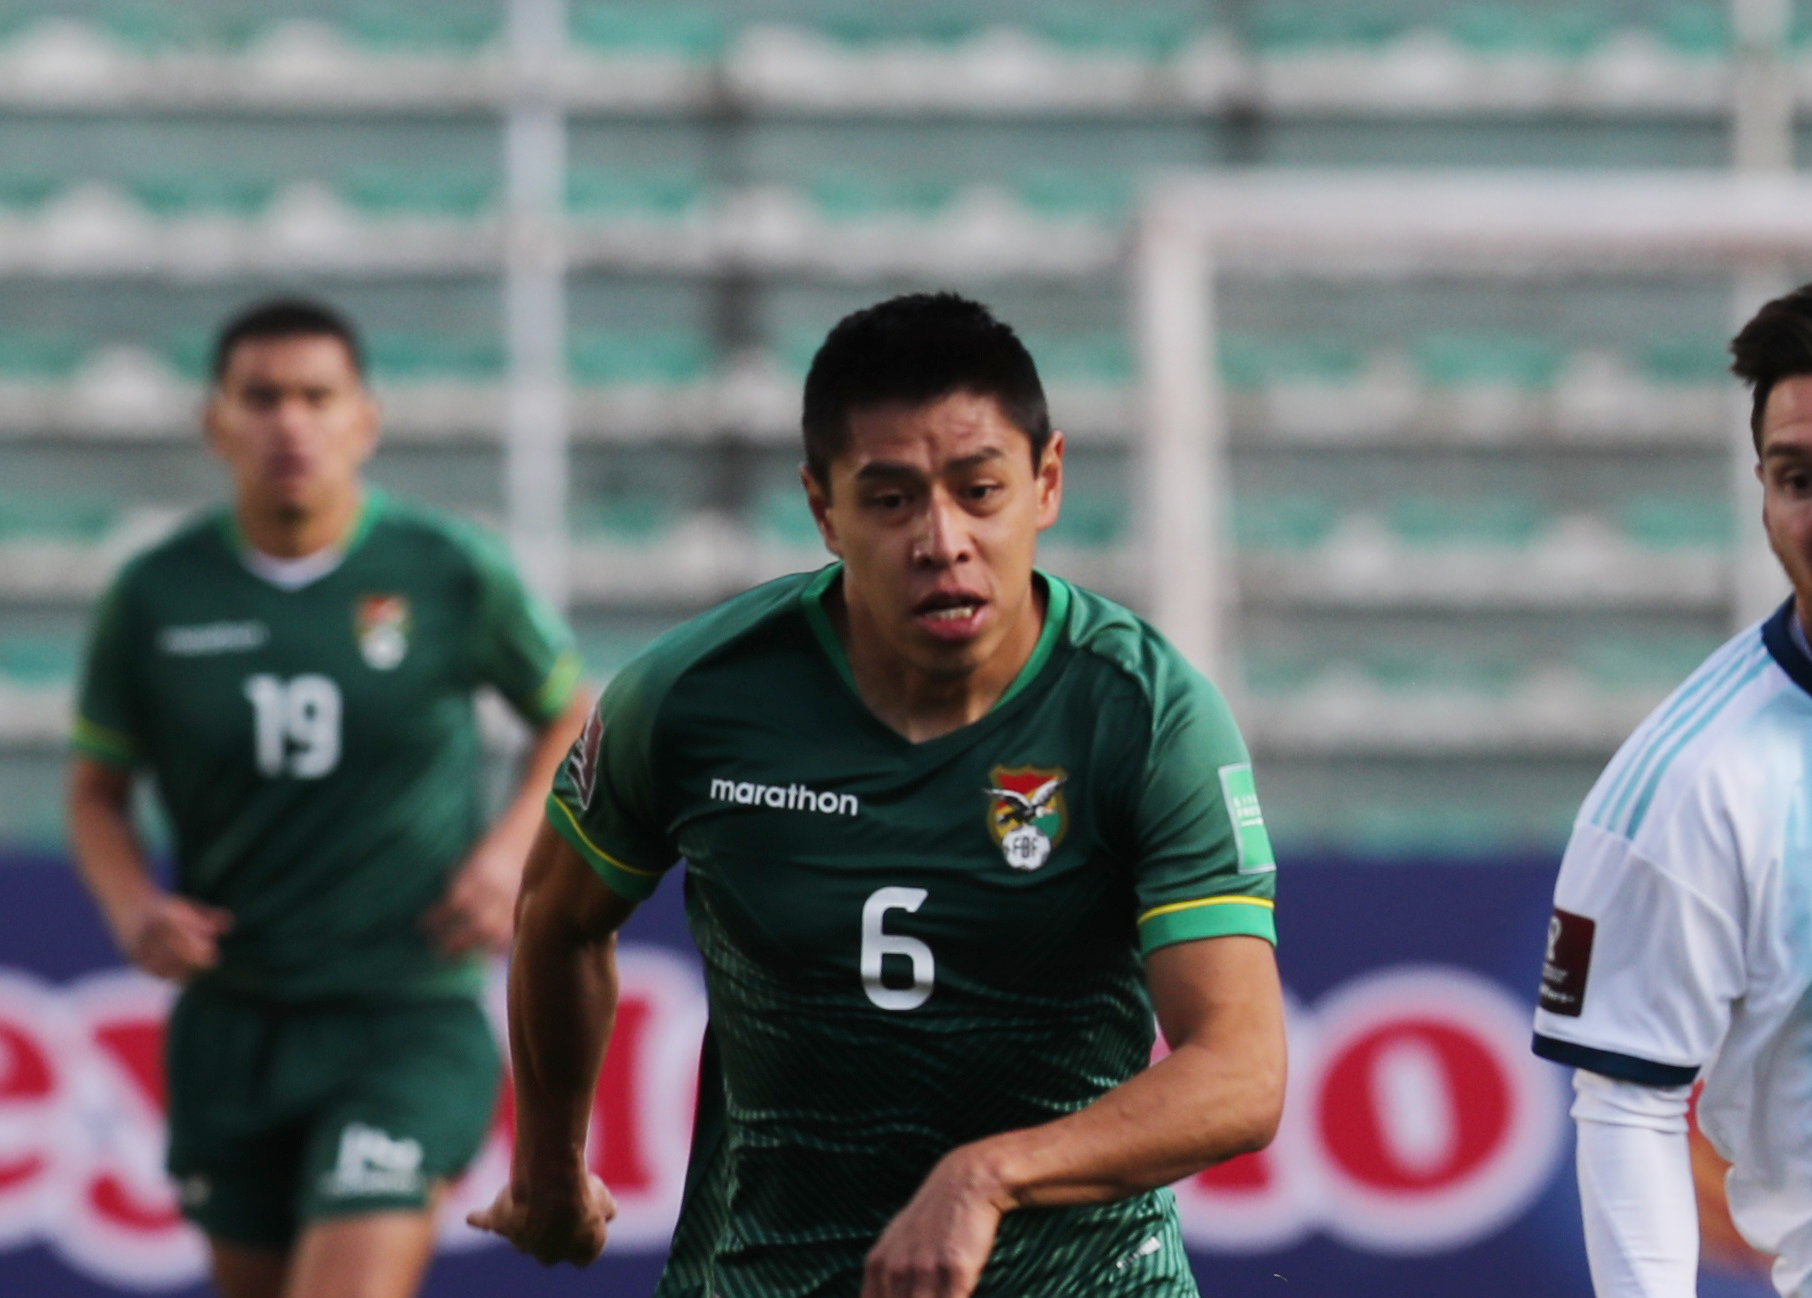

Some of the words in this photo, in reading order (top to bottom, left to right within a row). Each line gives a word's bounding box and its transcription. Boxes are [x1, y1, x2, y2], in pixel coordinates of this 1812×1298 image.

[243, 671, 343, 778] 19
[710, 777, 859, 816] marathon
[861, 885, 935, 1011] 6
